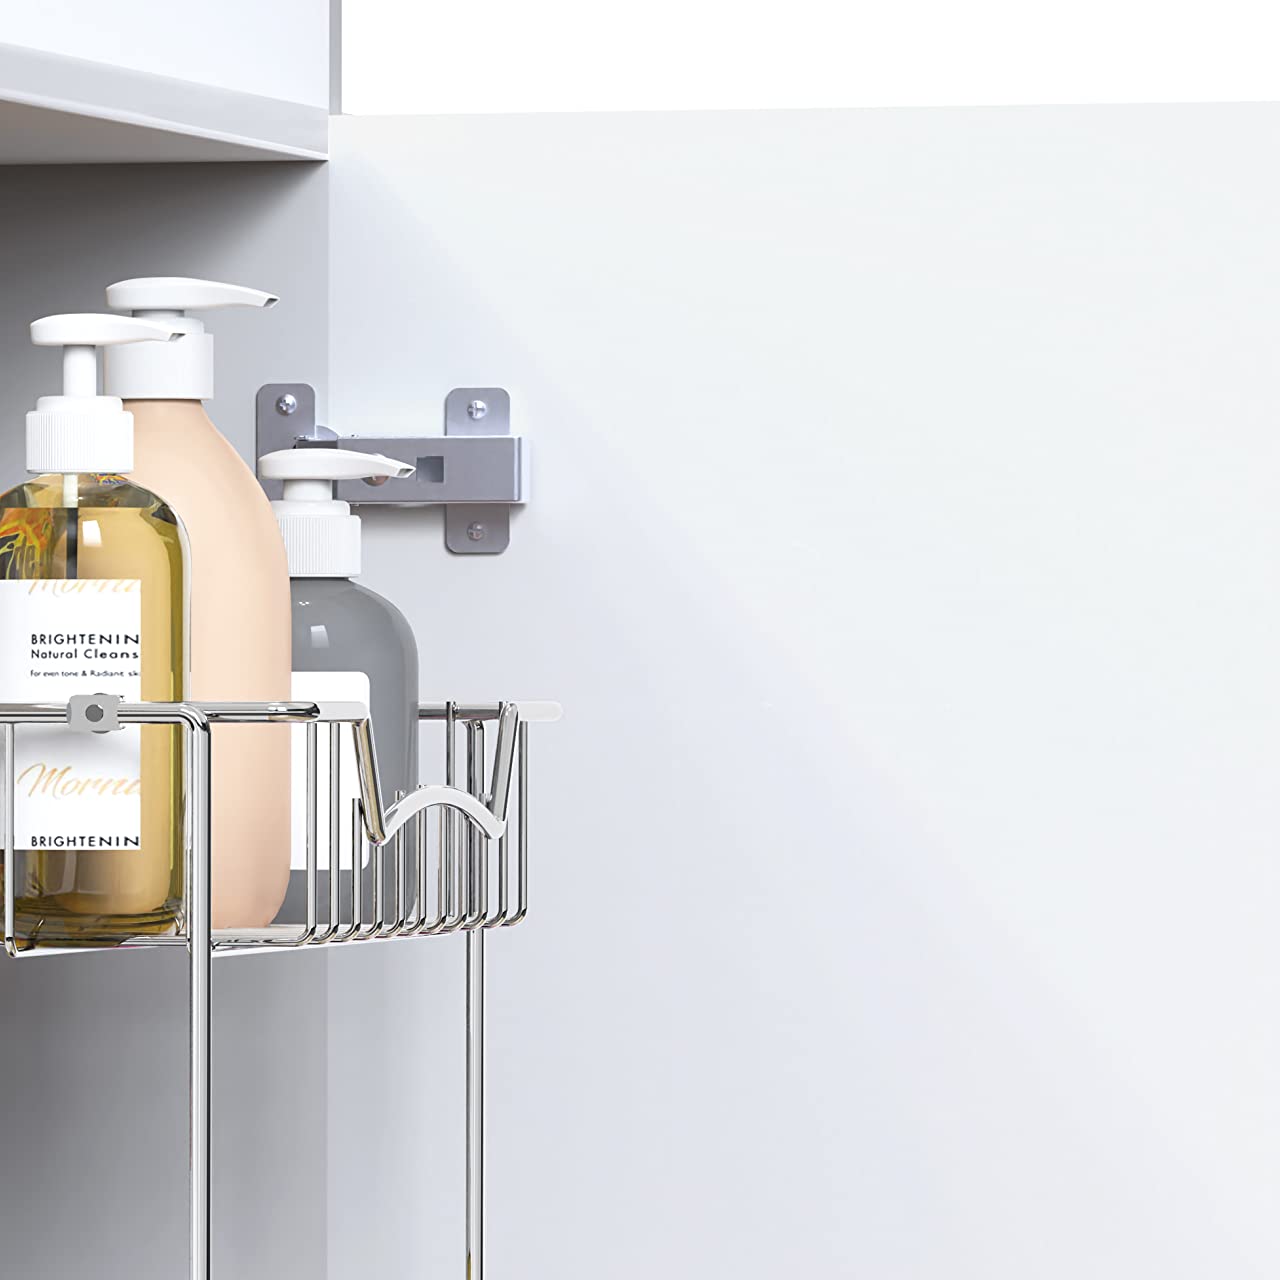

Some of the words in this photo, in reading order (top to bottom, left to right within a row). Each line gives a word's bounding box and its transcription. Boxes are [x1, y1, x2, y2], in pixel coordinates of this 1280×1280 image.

[31, 633, 139, 645] BRIGHTENIN
[31, 648, 78, 659] Natural
[83, 648, 139, 660] Cleans
[31, 836, 139, 847] BRIGHTENIN
